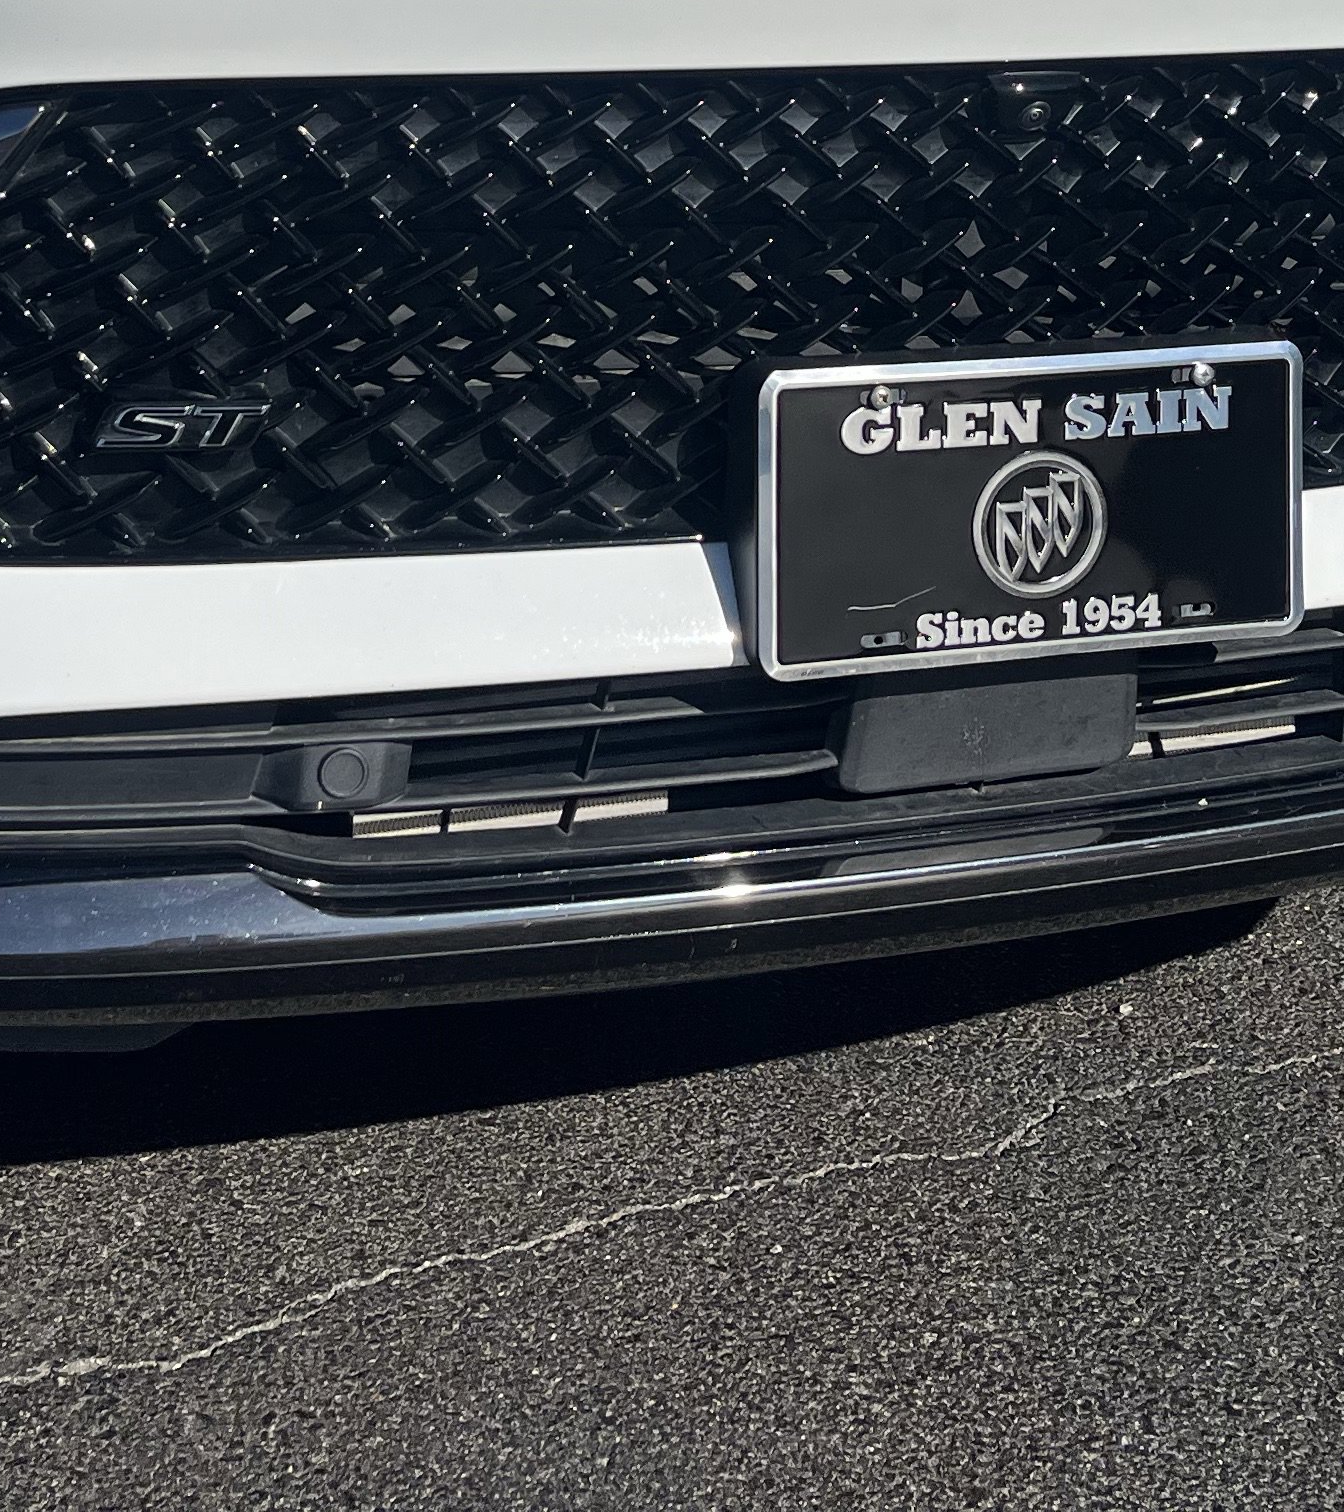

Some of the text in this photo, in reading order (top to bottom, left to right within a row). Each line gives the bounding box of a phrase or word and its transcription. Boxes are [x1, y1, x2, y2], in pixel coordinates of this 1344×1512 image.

[96, 403, 272, 448] ST
[841, 385, 1233, 455] GLEN SAIN
[915, 593, 1162, 650] Since 1954
